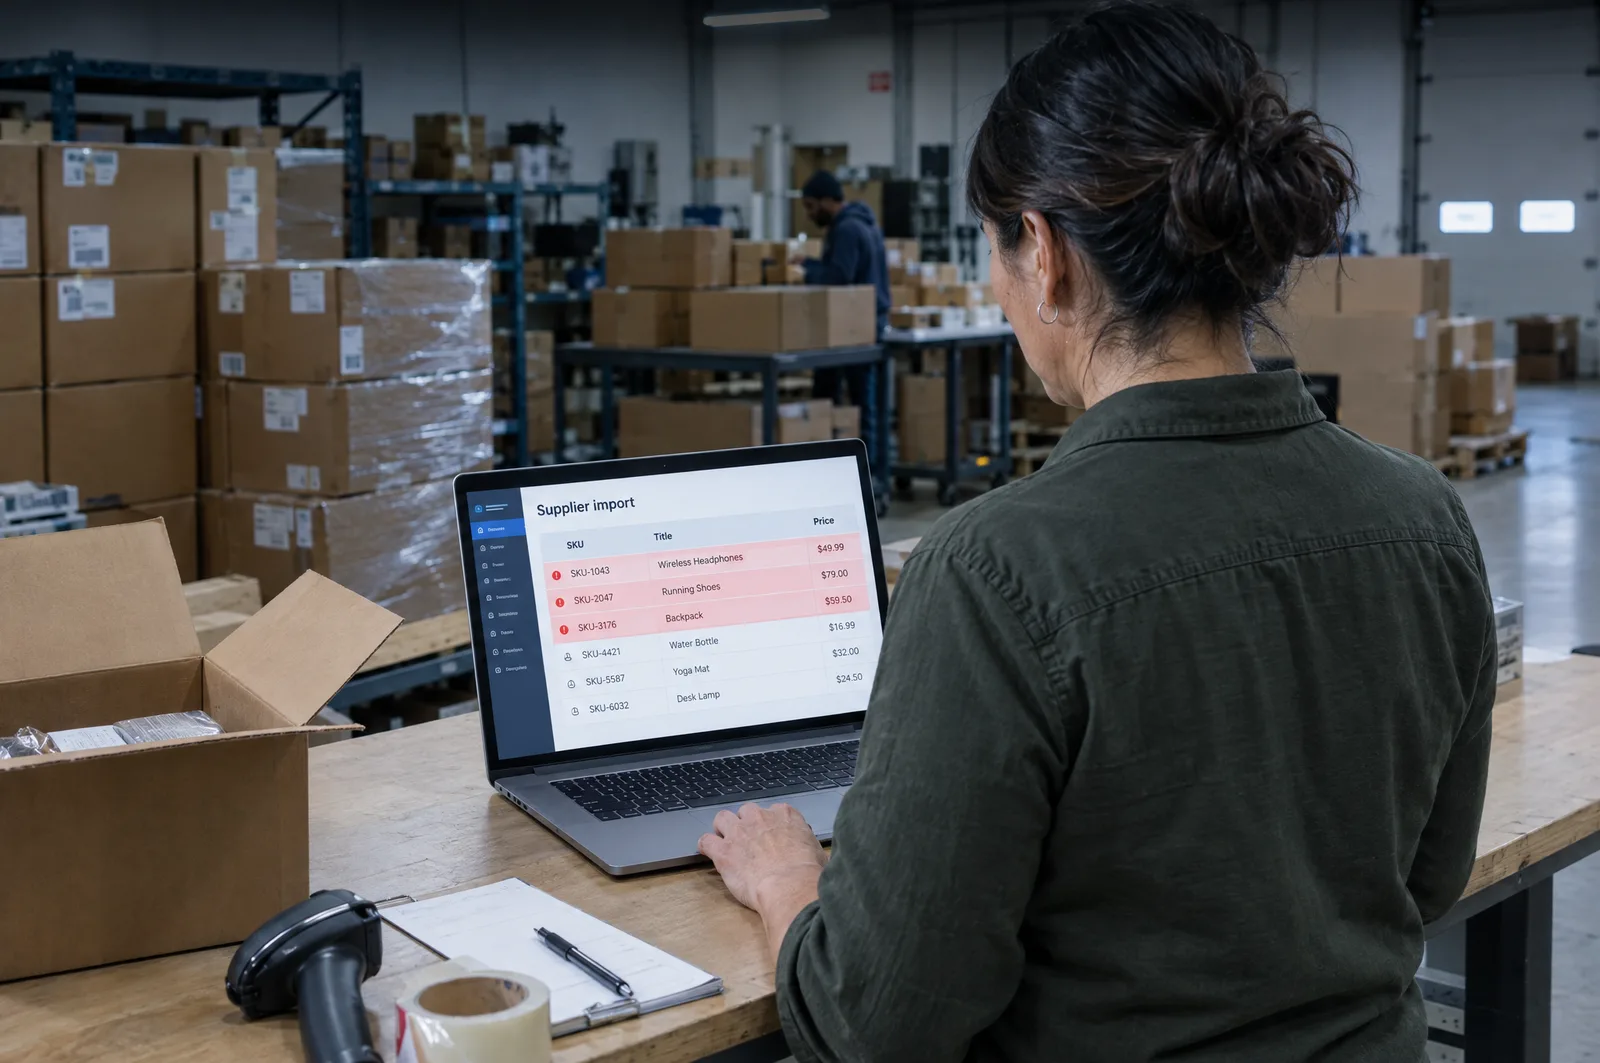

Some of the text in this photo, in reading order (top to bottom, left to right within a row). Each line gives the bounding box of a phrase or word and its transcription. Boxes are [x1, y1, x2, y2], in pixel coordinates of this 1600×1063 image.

[536, 497, 635, 517] Supplier import
[813, 517, 835, 526] Price
[654, 532, 673, 541] Title
[567, 540, 584, 549] SKU
[817, 543, 844, 554] $49.99
[657, 553, 744, 569] Wireless Headphones
[570, 566, 610, 578] SKU-1043
[821, 569, 849, 580] $79.00
[661, 583, 721, 596] Running Shoes
[574, 593, 614, 605] SKU-2047
[825, 595, 852, 606] $59.50
[665, 611, 704, 623] Backpack
[578, 620, 617, 632] SKU-3176
[828, 621, 855, 632] $16.99
[669, 637, 719, 649] Water Bottle
[582, 647, 621, 659] SKU-4421
[832, 647, 860, 658] $32.00
[673, 664, 710, 677] Yoga Mat
[585, 674, 625, 686] SKU-5587
[836, 673, 863, 684] $24.50
[677, 691, 720, 703] Desk Lamp
[589, 701, 630, 714] SKU-6032
